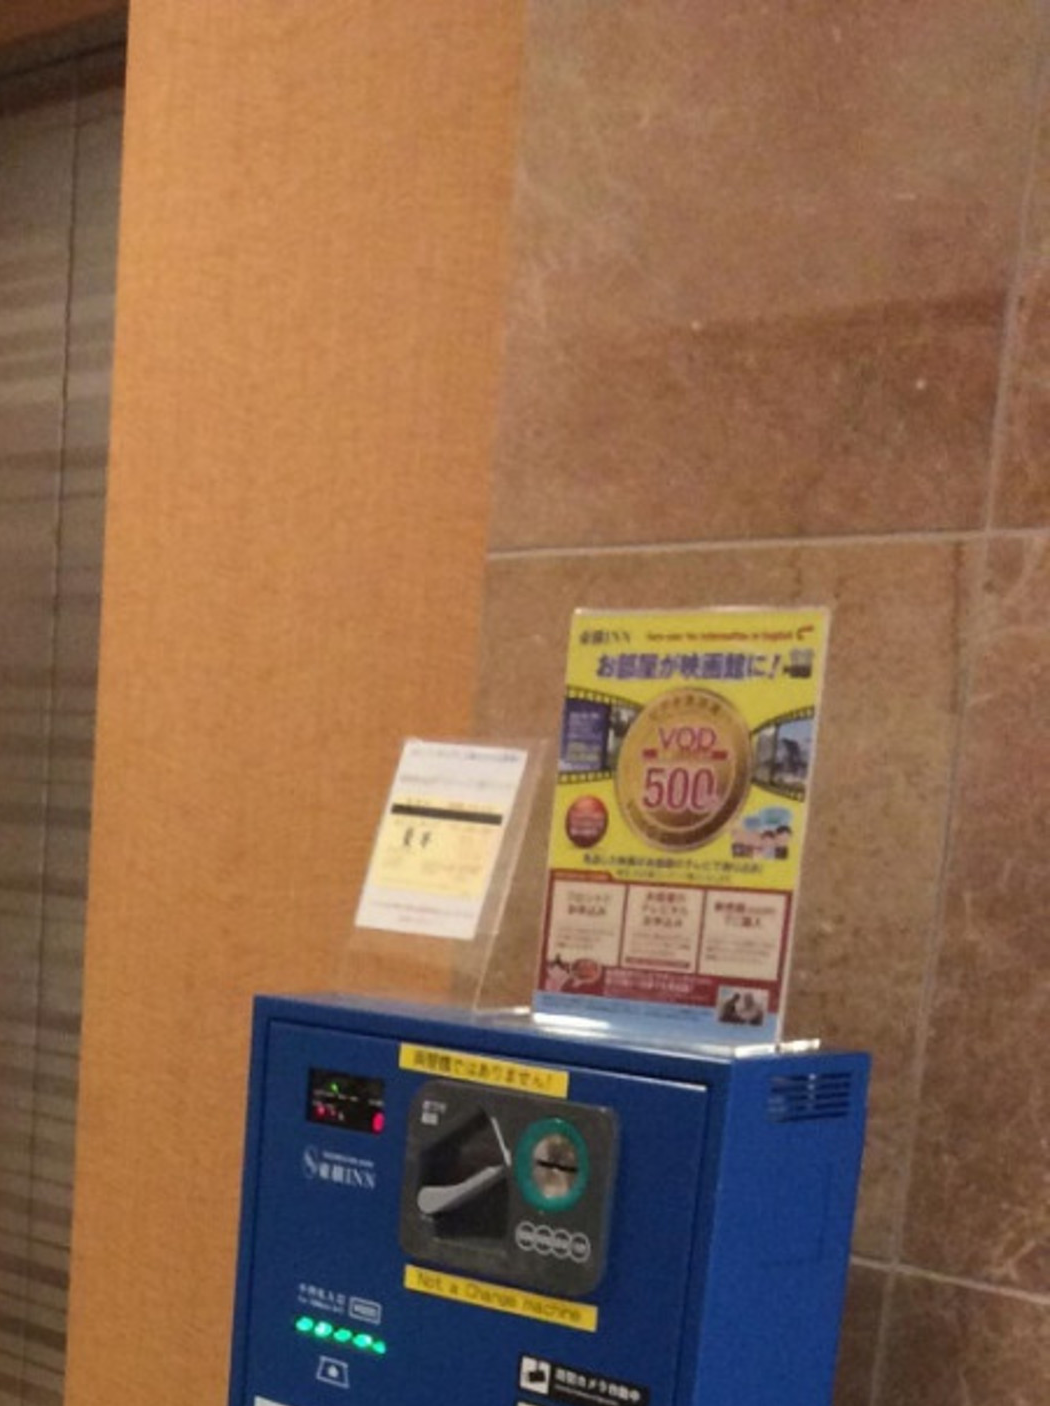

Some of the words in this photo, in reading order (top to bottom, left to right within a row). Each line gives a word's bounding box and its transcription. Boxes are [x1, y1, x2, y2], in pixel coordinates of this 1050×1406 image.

[417, 1272, 442, 1290] Not
[450, 1283, 459, 1294] a
[465, 1283, 518, 1308] Change
[521, 1297, 582, 1322] machine
